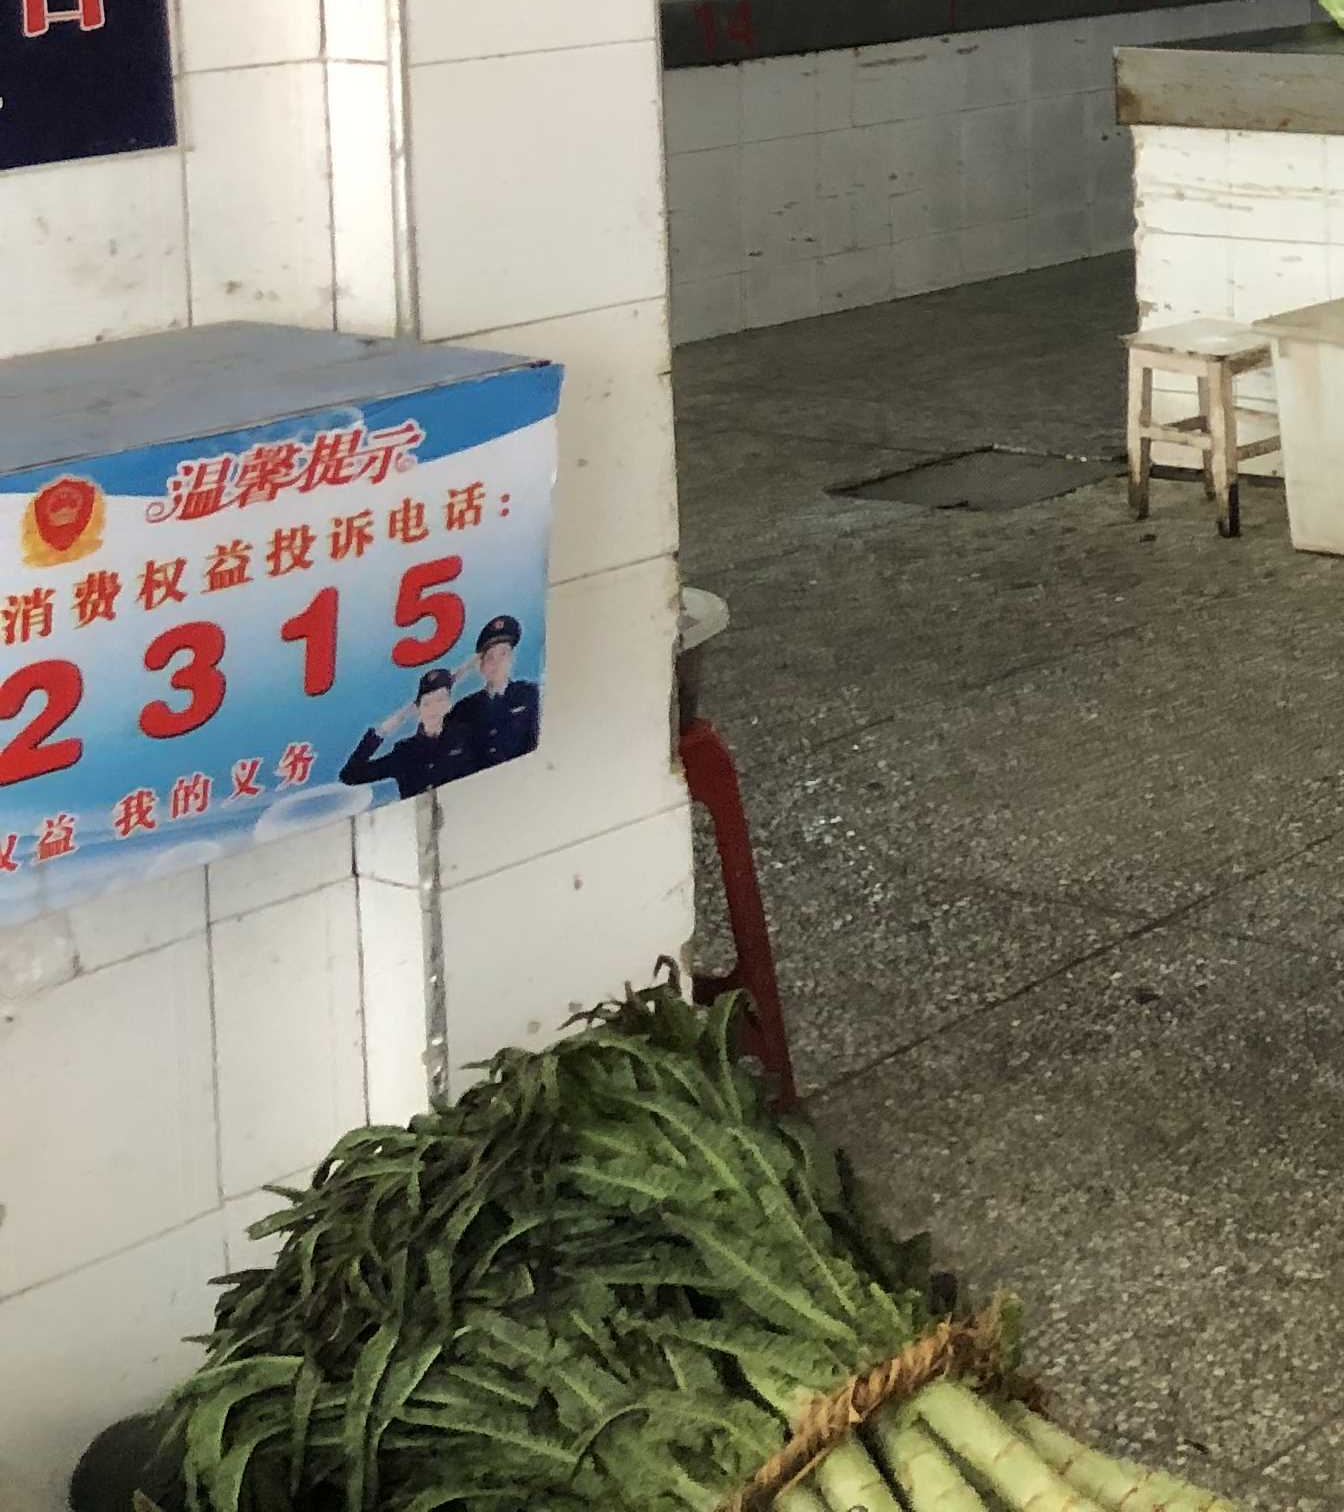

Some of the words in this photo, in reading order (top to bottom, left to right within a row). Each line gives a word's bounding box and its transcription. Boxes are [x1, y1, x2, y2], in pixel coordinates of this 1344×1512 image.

[695, 2, 757, 51] 14
[146, 418, 425, 522] 温馨提示
[0, 480, 512, 644] 消费权益投诉电话：
[112, 743, 318, 840] 我的义务
